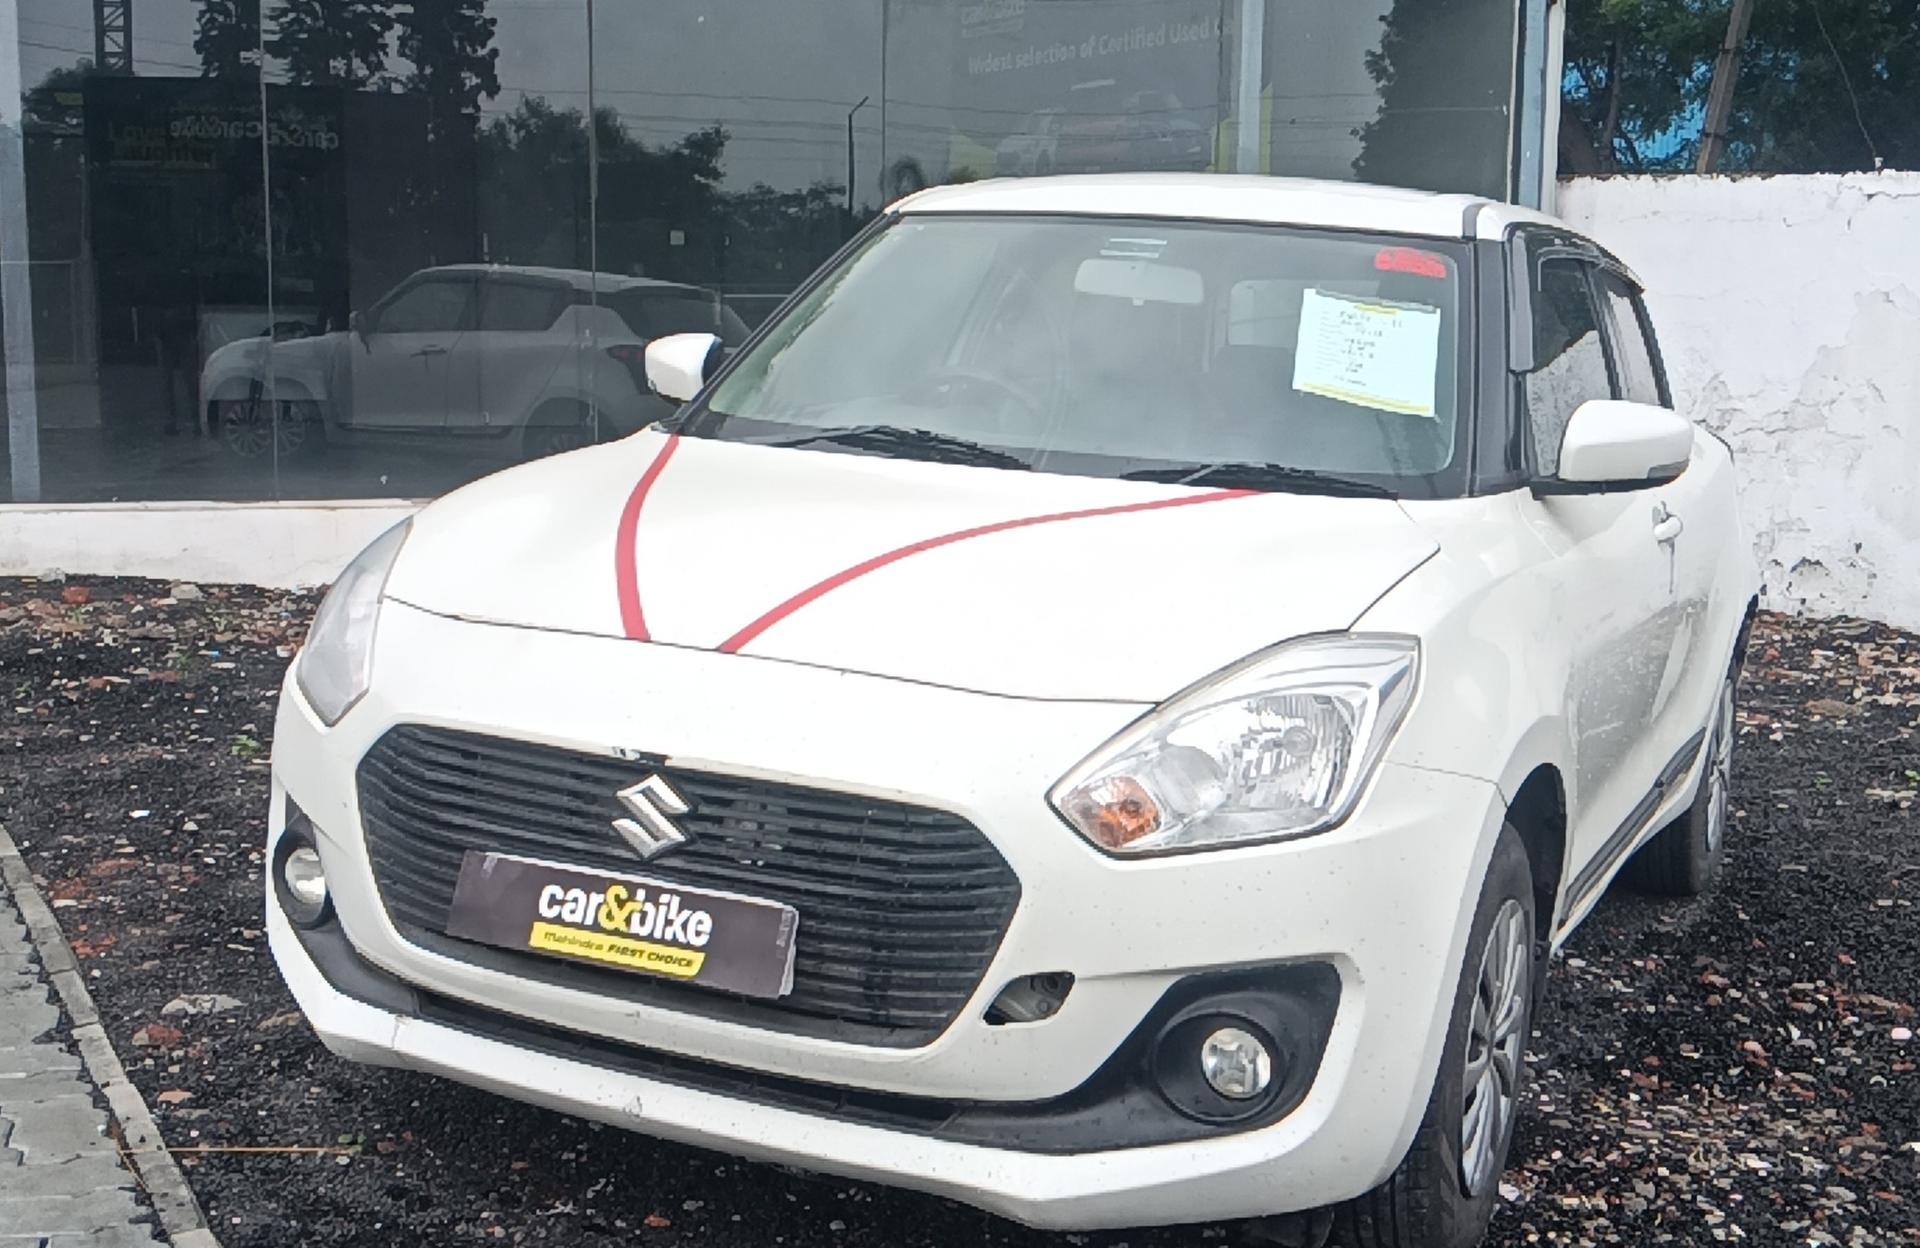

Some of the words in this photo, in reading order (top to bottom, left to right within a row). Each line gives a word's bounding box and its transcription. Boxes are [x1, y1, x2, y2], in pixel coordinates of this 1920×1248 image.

[1015, 43, 1075, 69] selection
[1080, 35, 1097, 57] of
[1169, 16, 1209, 43] Used
[538, 884, 713, 947] car&bike
[607, 944, 646, 959] FIRST
[647, 951, 694, 967] CHOICE
